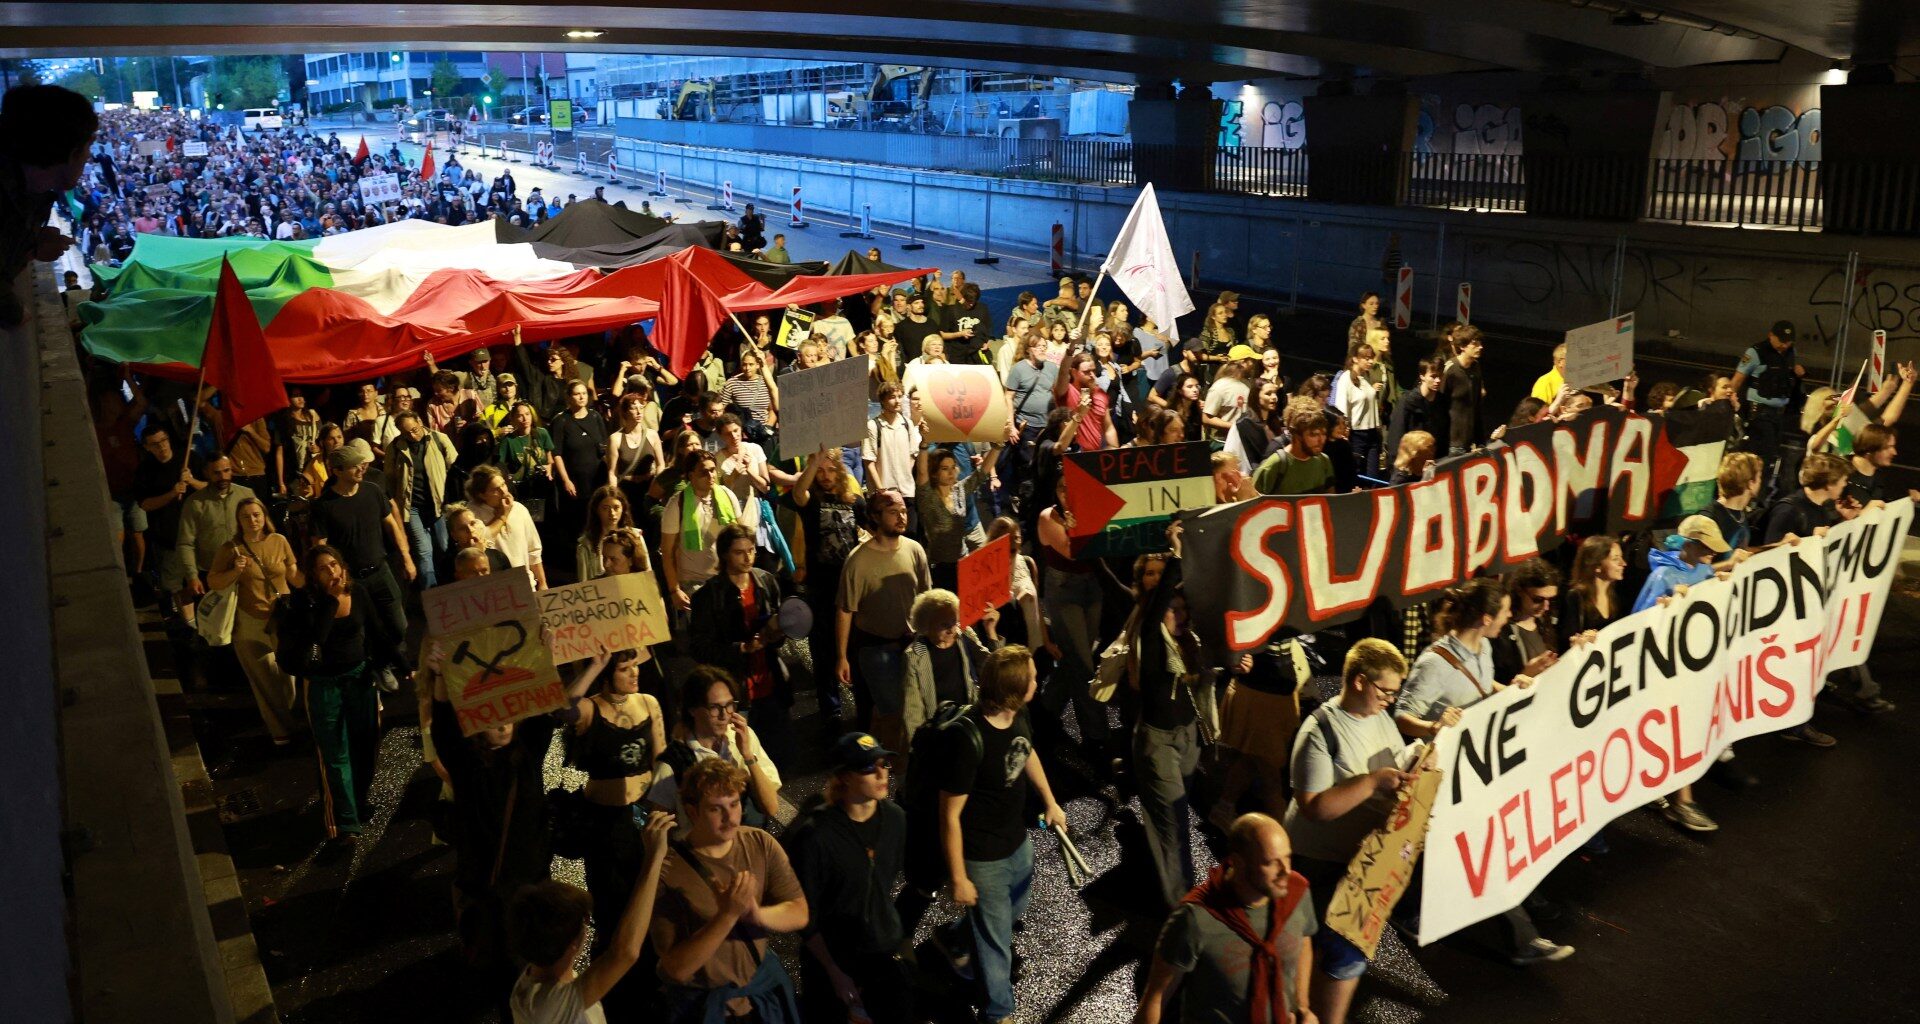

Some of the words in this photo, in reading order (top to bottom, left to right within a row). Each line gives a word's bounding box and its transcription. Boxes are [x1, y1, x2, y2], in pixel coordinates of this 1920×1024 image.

[1100, 446, 1188, 481] PEACE
[1148, 486, 1181, 511] IN
[541, 597, 651, 628] BOMBARDIRA
[555, 624, 592, 640] ATO
[1452, 693, 1536, 805] NE
